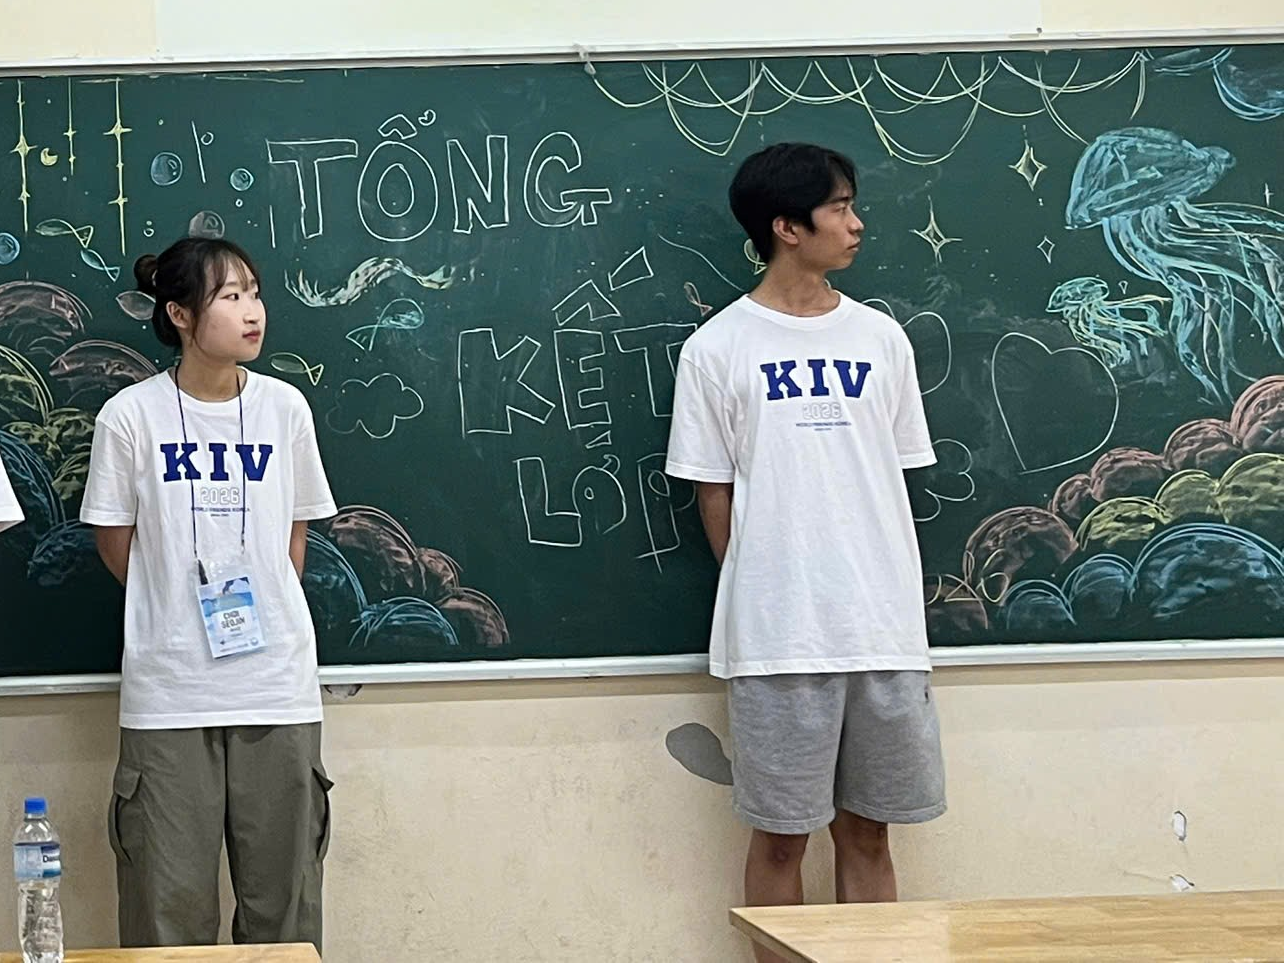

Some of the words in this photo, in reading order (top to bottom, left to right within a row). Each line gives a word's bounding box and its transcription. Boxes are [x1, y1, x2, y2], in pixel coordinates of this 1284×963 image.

[265, 107, 613, 242] TỔNG
[457, 245, 699, 439] KẾT
[760, 358, 872, 401] KIV
[159, 441, 273, 483] KIV
[200, 486, 241, 505] 2026
